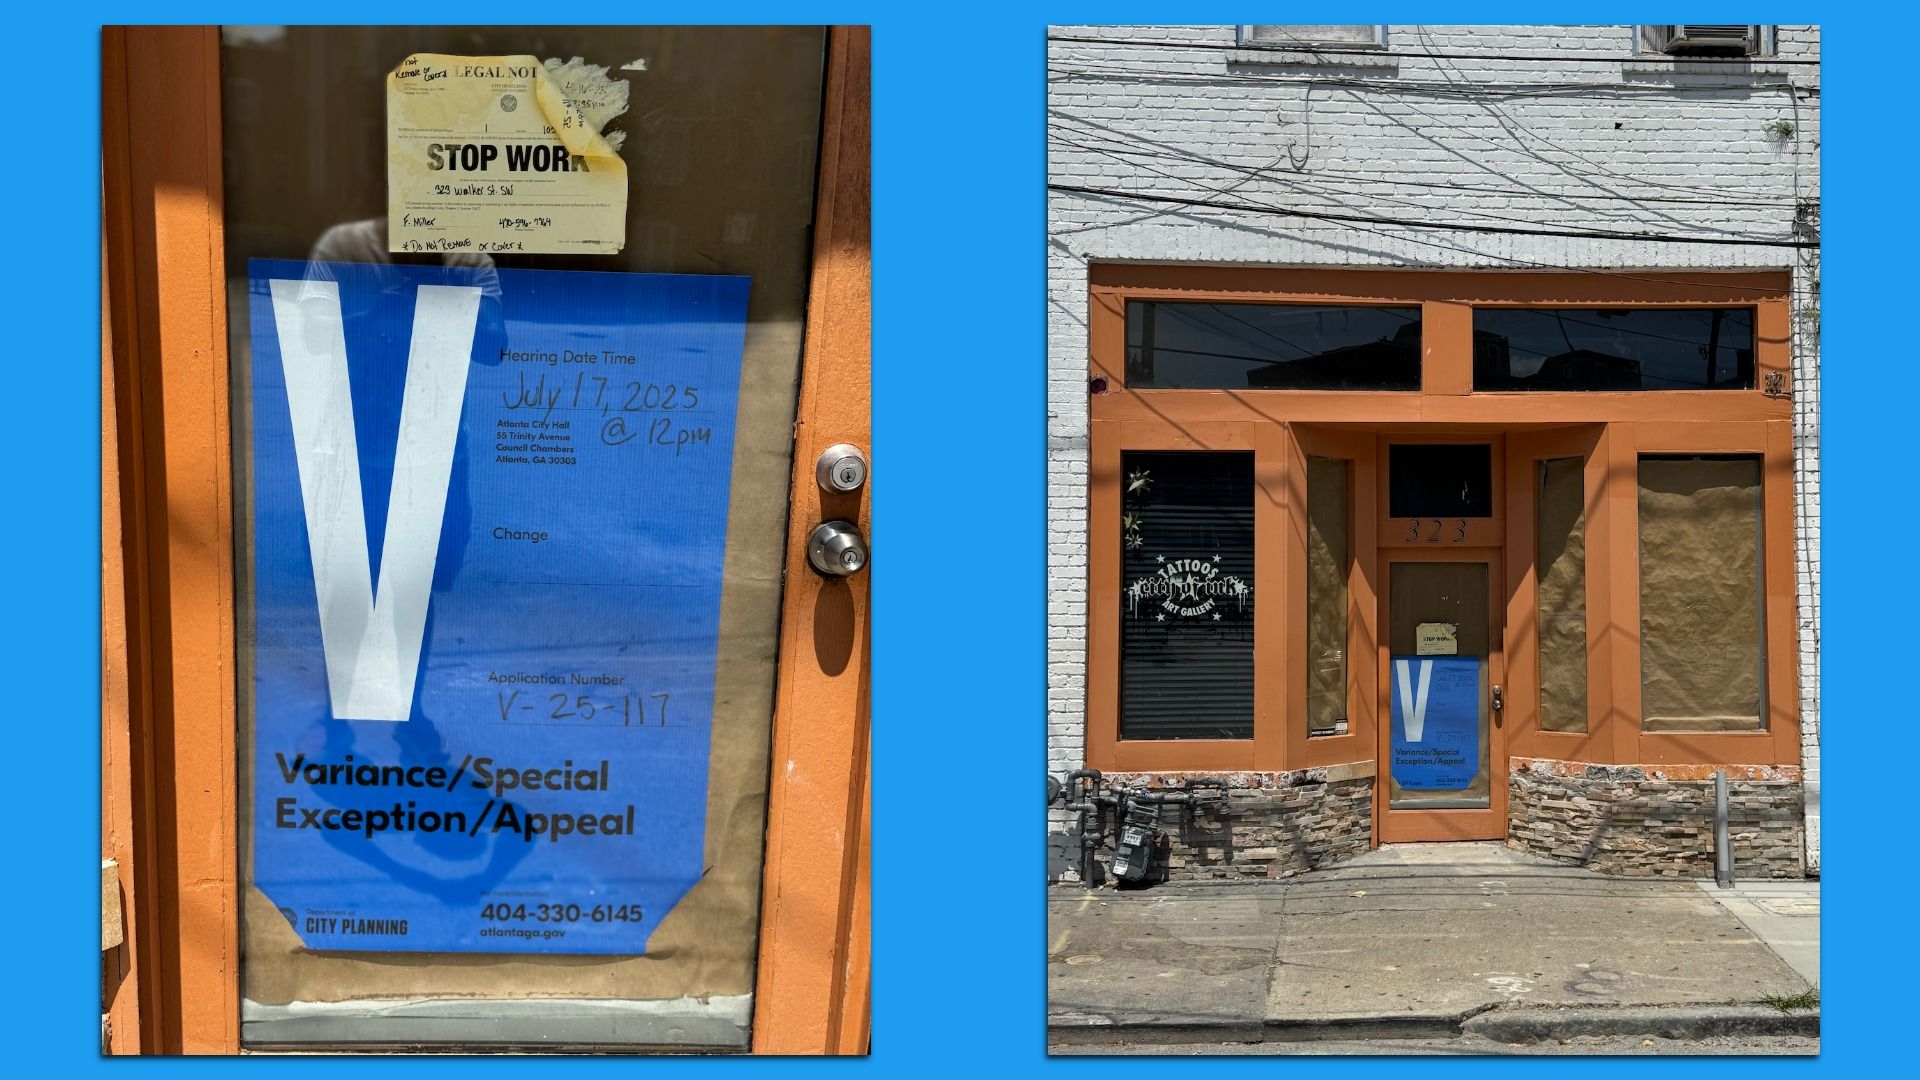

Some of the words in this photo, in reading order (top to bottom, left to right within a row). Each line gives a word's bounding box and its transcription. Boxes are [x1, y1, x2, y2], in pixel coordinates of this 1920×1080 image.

[456, 65, 504, 79] LEGAL
[427, 144, 498, 171] STOP
[435, 184, 450, 195] 323
[501, 184, 514, 196] SW
[500, 348, 558, 367] Hearing
[563, 350, 598, 365] Date
[602, 351, 637, 365] Time
[503, 371, 561, 424] July
[573, 371, 609, 418] 17,
[624, 381, 699, 411] 2025
[496, 420, 530, 429] Atlanta
[532, 420, 549, 431] City
[552, 420, 570, 429] Hall
[601, 417, 637, 446] @
[496, 432, 507, 440] 55
[510, 432, 536, 441] Trinity
[538, 433, 571, 442] Avenue
[496, 444, 528, 453] Council
[530, 445, 574, 454] Chambers
[496, 456, 530, 465] Atlanta,
[533, 457, 546, 465] GA
[549, 457, 577, 466] 30303
[269, 279, 483, 721] V
[493, 527, 548, 544] Change
[1405, 519, 1467, 543] 323
[1157, 559, 1219, 580] TATTOOS
[1161, 599, 1180, 614] ART
[1180, 598, 1217, 617] GALLERY
[488, 673, 566, 687] Application
[571, 674, 625, 687] Number
[1396, 659, 1433, 743] V
[1396, 748, 1460, 759] Variance/Special
[1396, 757, 1466, 768] Exception/Appeal
[276, 752, 609, 797] Variance/Special
[276, 798, 636, 843] Exception/Appeal
[481, 903, 644, 923] 404-330-6145
[306, 917, 337, 935] CITY
[342, 918, 409, 937] PLANNING
[480, 928, 567, 941] atlantaga.gov
